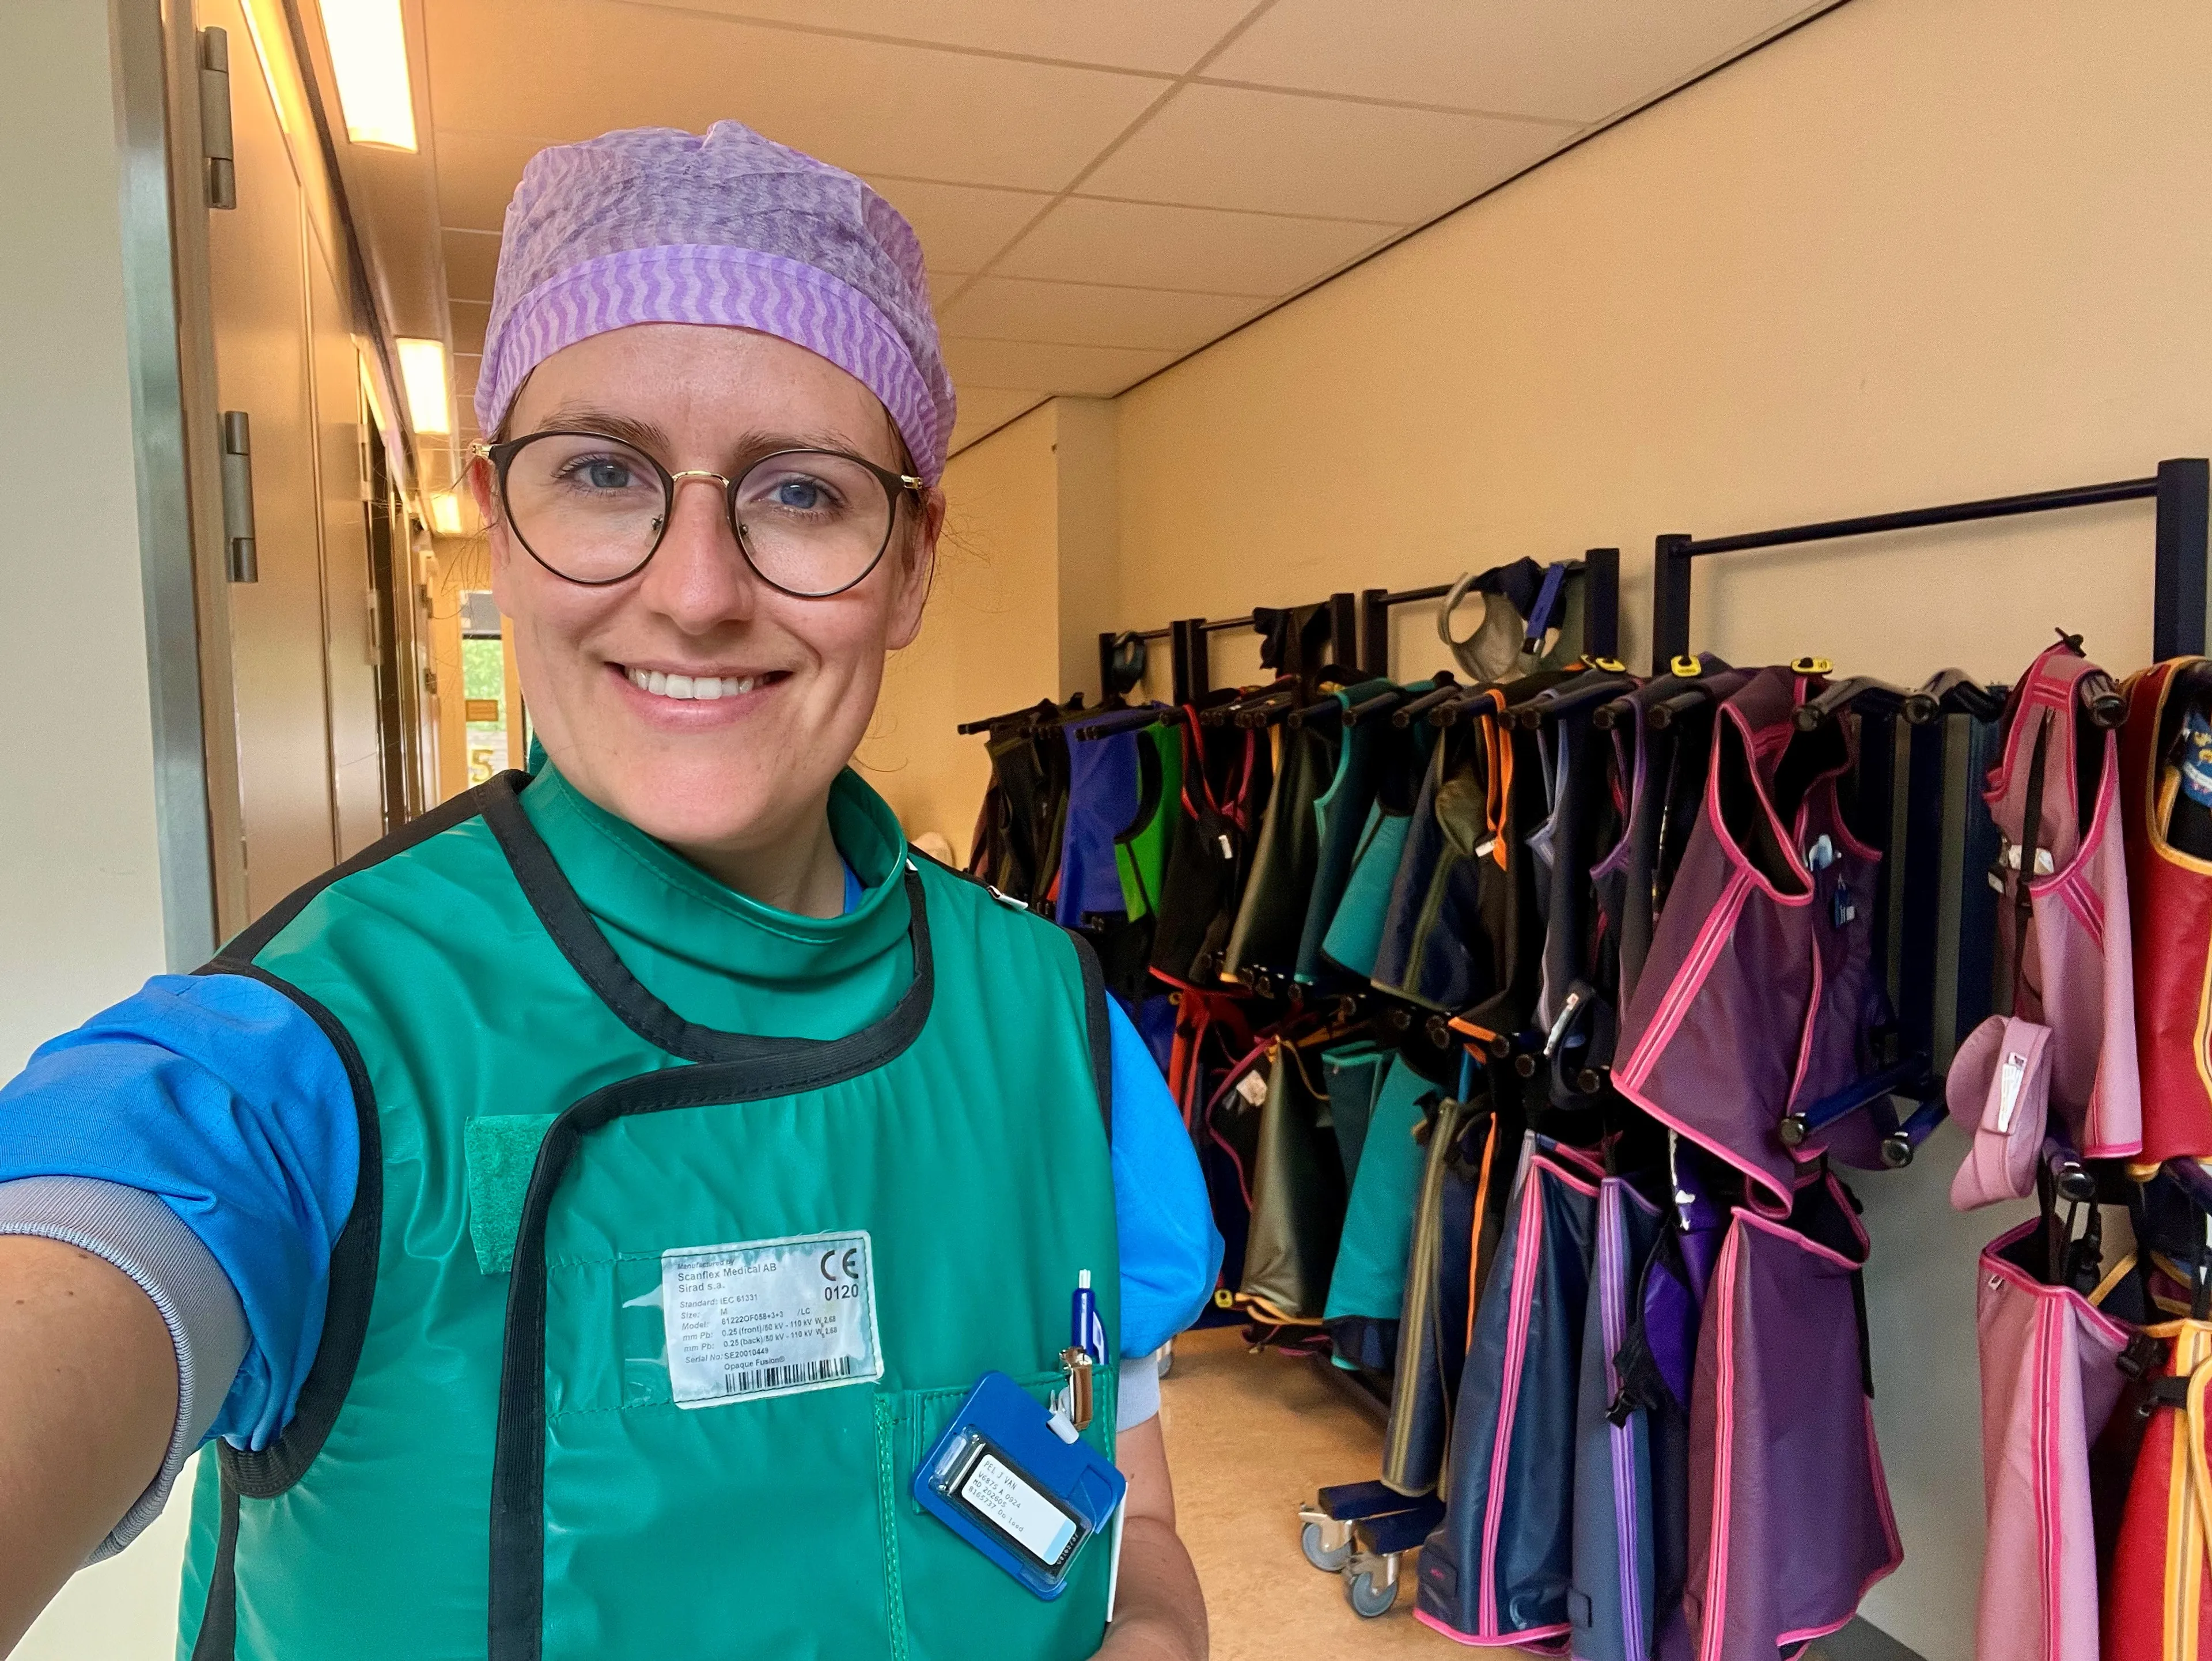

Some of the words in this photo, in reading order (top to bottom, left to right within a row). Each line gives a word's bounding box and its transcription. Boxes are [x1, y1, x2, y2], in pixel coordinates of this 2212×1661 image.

[471, 750, 493, 782] 5
[678, 1270, 720, 1281] Scanflex
[724, 1265, 760, 1277] Medical
[763, 1263, 777, 1272] AB
[679, 1282, 704, 1293] Sirad
[708, 1282, 725, 1291] s.a.
[824, 1284, 859, 1301] 0120
[680, 1298, 718, 1308] Standard:
[721, 1296, 734, 1304] IEC
[736, 1293, 758, 1303] 61331
[682, 1321, 708, 1330] Model:
[700, 1331, 713, 1340] Pb:
[722, 1328, 738, 1337] 0.25
[791, 1320, 802, 1328] 110
[684, 1344, 698, 1352] mm
[701, 1342, 714, 1350] Pb:
[791, 1330, 802, 1338] 110
[685, 1354, 708, 1364] Serial
[725, 1361, 753, 1371] Opaque
[978, 1471, 999, 1489] V6875
[1005, 1494, 1021, 1509] 0924
[1006, 1477, 1017, 1490] VAN
[968, 1486, 995, 1510] 8165737
[983, 1486, 1007, 1508] 202605
